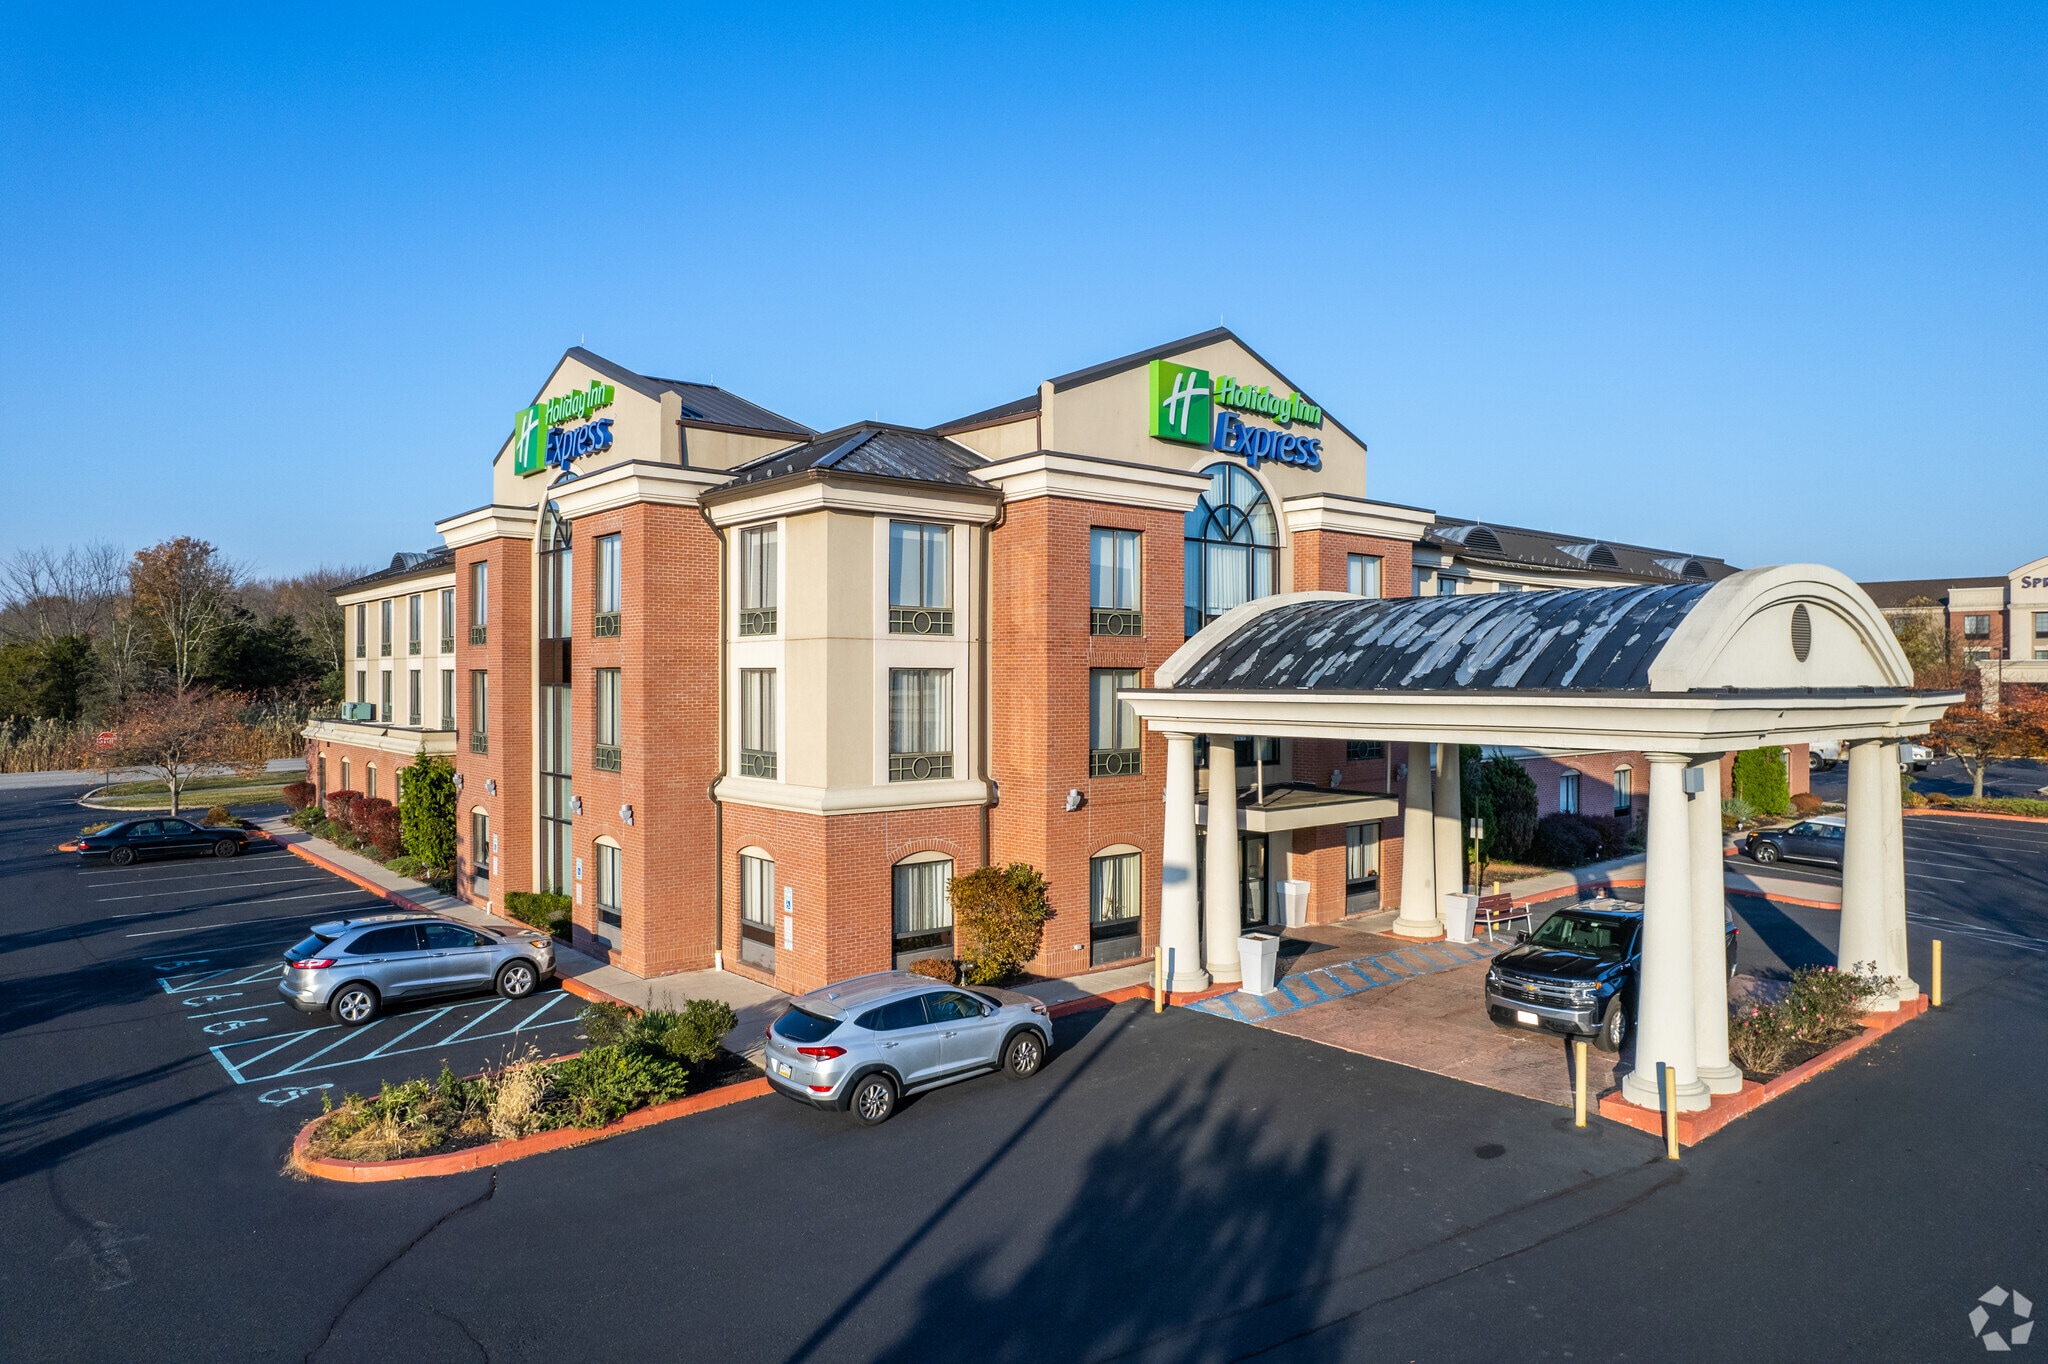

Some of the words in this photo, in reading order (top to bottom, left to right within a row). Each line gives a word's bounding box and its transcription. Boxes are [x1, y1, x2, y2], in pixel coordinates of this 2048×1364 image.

[545, 389, 588, 426] Holiday
[587, 379, 613, 408] Inn
[1215, 375, 1292, 424] Holiday
[1291, 392, 1322, 424] Inn
[545, 418, 613, 470] Express
[1214, 411, 1322, 467] Express
